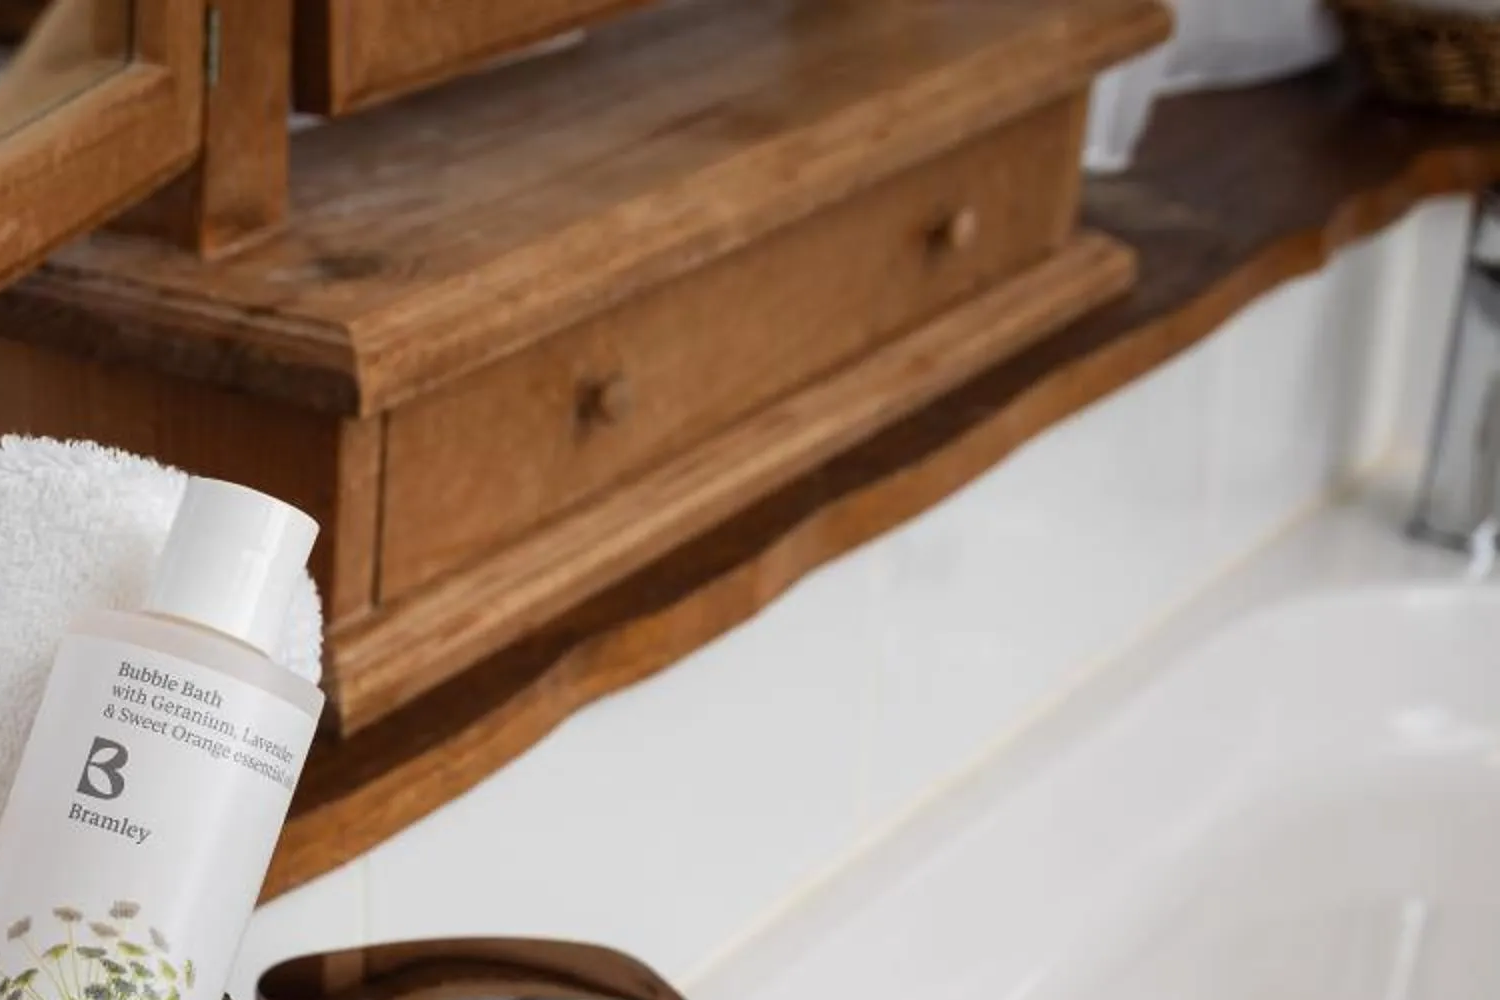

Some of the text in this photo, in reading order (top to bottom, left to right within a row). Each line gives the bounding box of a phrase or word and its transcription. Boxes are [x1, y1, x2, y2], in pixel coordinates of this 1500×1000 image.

[112, 683, 147, 707] with
[117, 660, 223, 708] Bubble Bath
[102, 702, 117, 720] &
[117, 706, 167, 736] Sweet
[171, 723, 230, 761] Orange
[68, 802, 152, 845] Bramley
